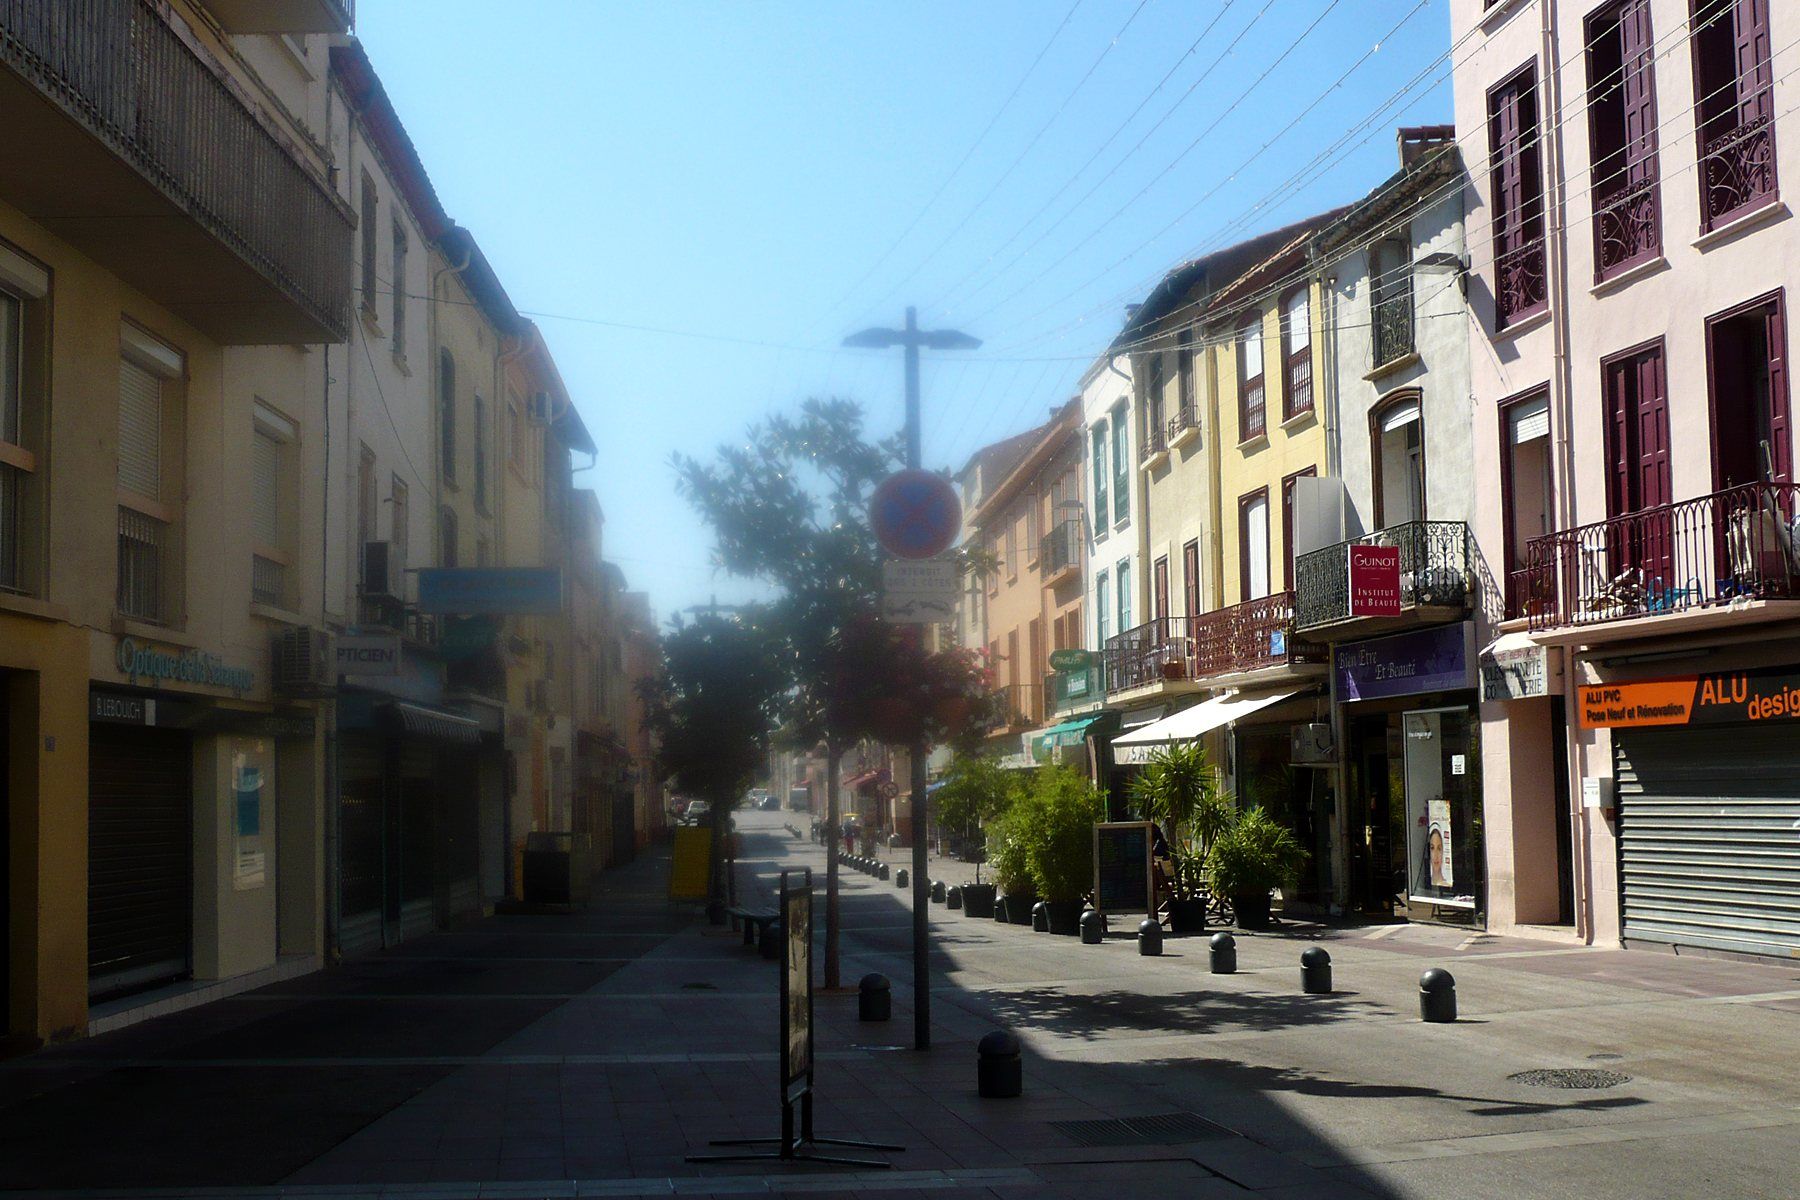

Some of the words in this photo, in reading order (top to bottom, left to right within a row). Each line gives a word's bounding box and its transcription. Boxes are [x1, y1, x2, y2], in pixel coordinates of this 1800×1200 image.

[1354, 554, 1396, 566] GUINOT
[1358, 588, 1394, 596] INSTITUT
[1354, 599, 1363, 607] DE
[336, 647, 393, 662] PTICIEN
[1338, 651, 1356, 669] Bien
[120, 637, 176, 689] Optique
[1375, 662, 1385, 680] Et
[1387, 659, 1415, 678] Beauté
[1586, 691, 1601, 704] ALU
[1603, 689, 1621, 703] PVC
[1700, 674, 1748, 706] ALU
[1586, 708, 1606, 723] Pose
[1607, 706, 1626, 721] Neuf
[1627, 706, 1635, 719] et
[1637, 702, 1685, 719] Rénovation
